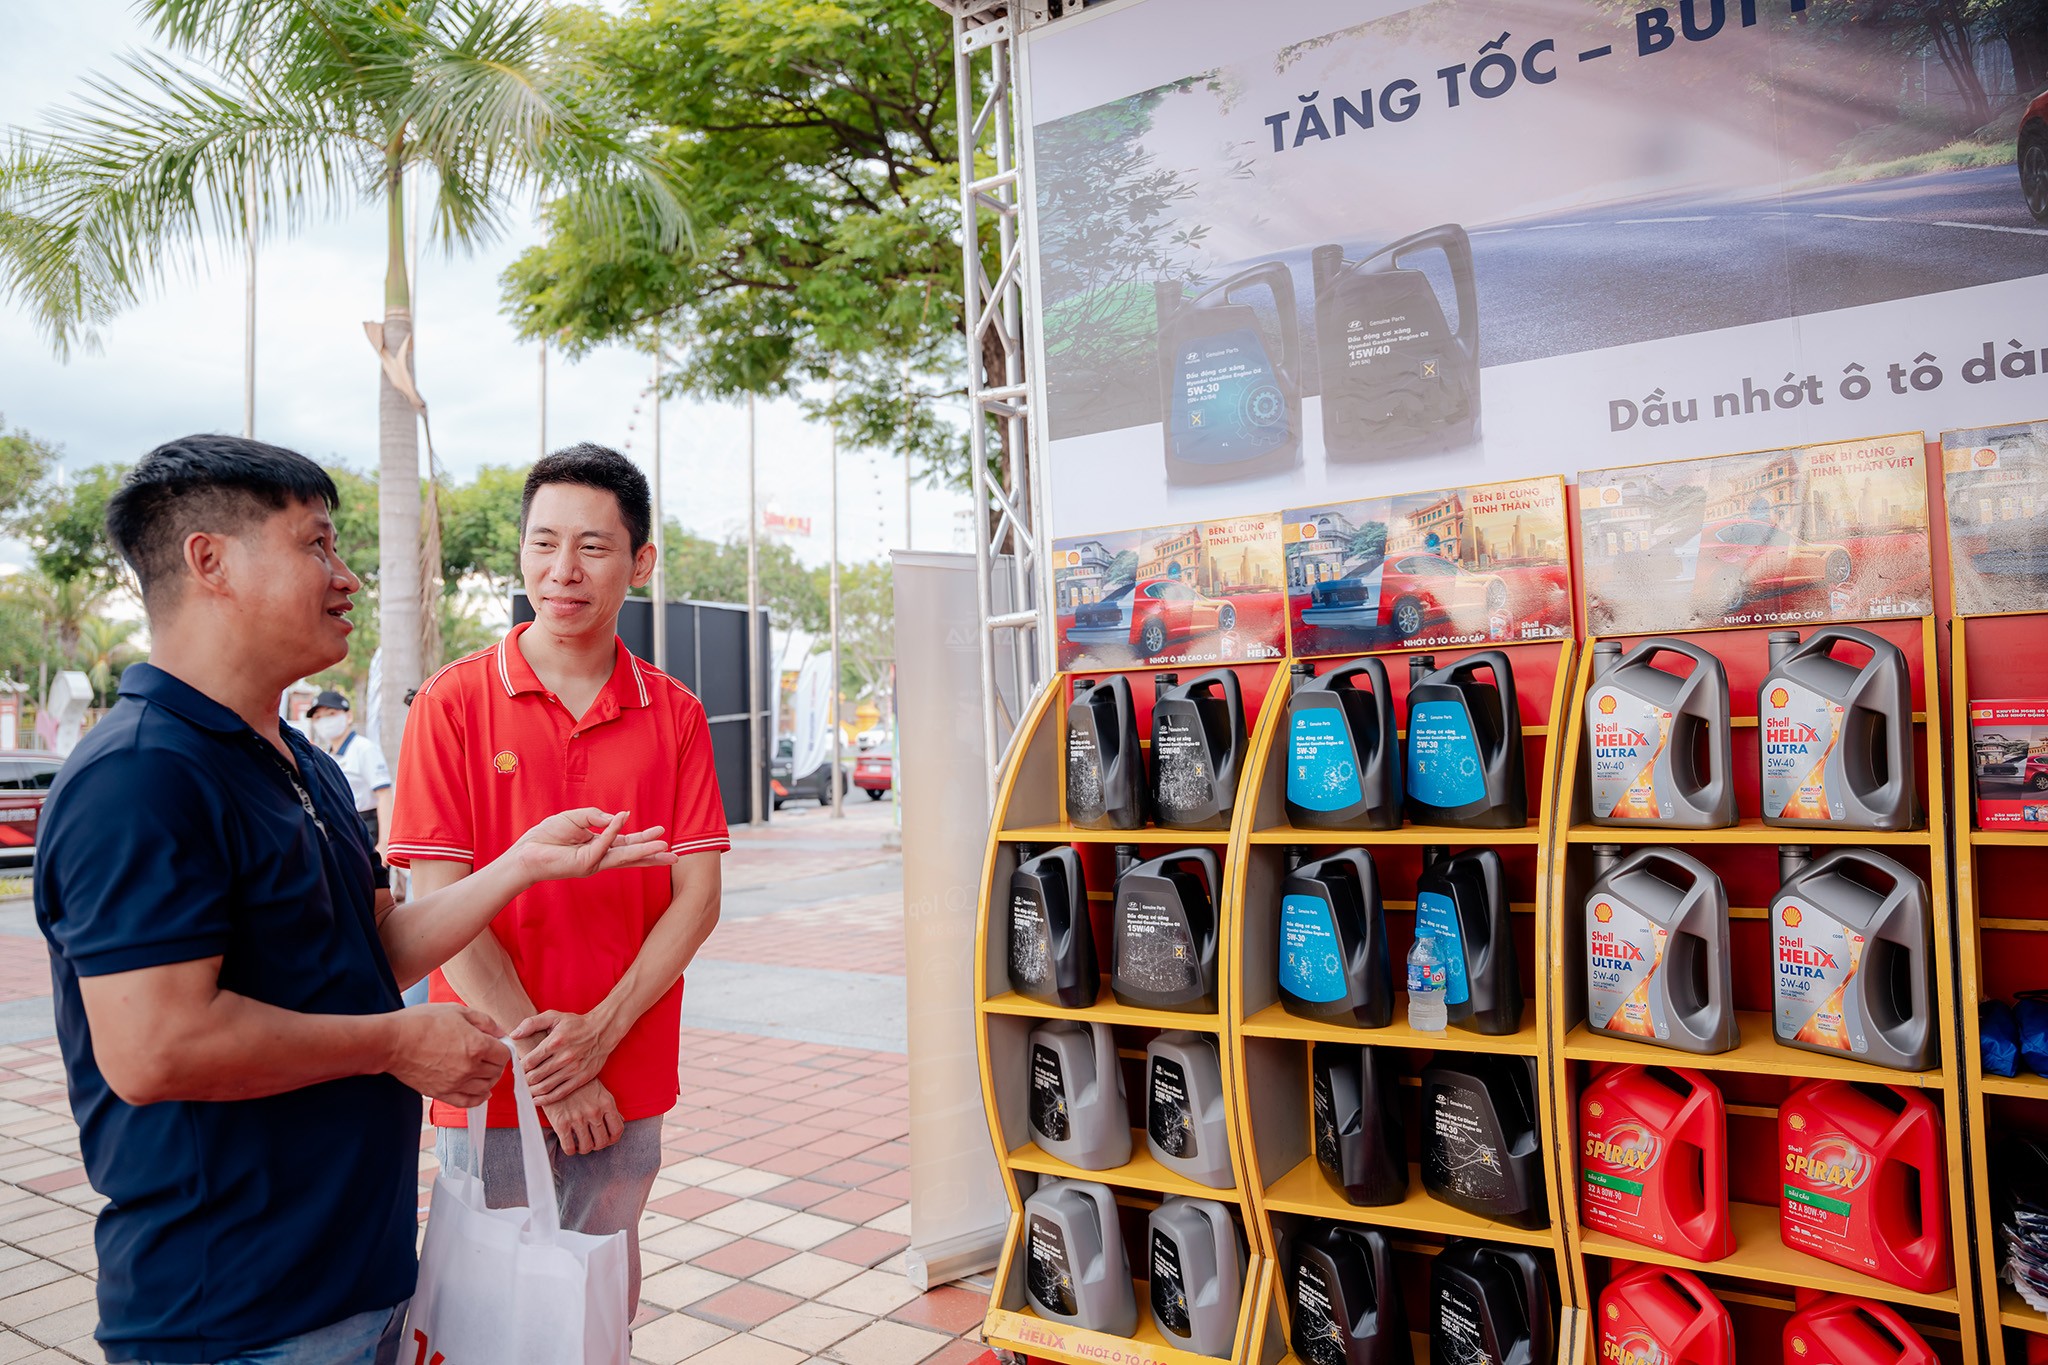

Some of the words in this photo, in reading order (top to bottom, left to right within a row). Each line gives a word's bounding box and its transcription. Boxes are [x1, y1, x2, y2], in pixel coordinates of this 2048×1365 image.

[1264, 78, 1422, 153] TĂNG
[1437, 31, 1557, 108] TỐC
[1369, 318, 1390, 327] Genuine
[1348, 341, 1371, 350] Hyundai
[1372, 337, 1398, 346] Gasoline
[1398, 333, 1419, 342] Engine
[1226, 347, 1239, 355] Parts
[1349, 345, 1390, 360] 15W/40
[1187, 383, 1219, 397] 5W-30
[1608, 386, 1698, 432] Dầu
[1713, 371, 1823, 418] nhớt
[1839, 361, 1871, 401] ô
[1887, 351, 1943, 394] tô
[1811, 466, 1842, 477] TINH
[1887, 456, 1914, 469] VIỆT
[1473, 505, 1498, 515] TINH
[1209, 536, 1230, 546] TINH
[1869, 596, 1891, 605] Shell
[1870, 600, 1922, 615] HELIX
[1724, 613, 1751, 624] NHỚT
[1753, 612, 1762, 622] Ô
[1765, 612, 1778, 622] TÔ
[1780, 611, 1801, 621] CAO
[1521, 621, 1539, 629] Shell
[1522, 624, 1563, 639] HELIX
[1247, 642, 1261, 650] Shell
[1403, 637, 1427, 647] NHỚT
[1428, 636, 1436, 645] Ô
[1437, 635, 1449, 645] TÔ
[1450, 634, 1467, 644] CAO
[1469, 632, 1485, 642] CẤP
[1149, 655, 1168, 664] NHỚT
[1177, 654, 1186, 663] TÔ
[1187, 653, 1202, 662] CAO
[1247, 645, 1281, 658] HELIX
[1595, 722, 1618, 733] Shell
[1767, 717, 1790, 727] Shell
[1596, 728, 1649, 747] HELIX
[1767, 723, 1821, 742] HELIX
[1296, 747, 1318, 755] 5W-30
[1416, 741, 1439, 749] 5W-30
[1767, 744, 1809, 755] ULTRA
[1596, 748, 1637, 758] ULTRA
[1597, 761, 1625, 771] 5W-40
[1767, 758, 1795, 768] 5W-40
[1127, 924, 1155, 934] 15W/40
[1592, 930, 1614, 942] Shell
[1287, 932, 1306, 942] 5W-30
[1779, 935, 1803, 949] Shell
[1592, 939, 1643, 961] HELIX
[1779, 945, 1838, 969] HELIX
[1592, 957, 1633, 972] ULTRA
[1780, 963, 1825, 980] ULTRA
[1593, 970, 1620, 983] 5W-40
[1780, 977, 1811, 992] 5W-40
[1436, 1121, 1458, 1135] 5W-30
[1587, 1130, 1602, 1139] Shell
[1585, 1139, 1649, 1171] SPIRAX
[1787, 1144, 1803, 1154] Shell
[1785, 1153, 1857, 1189] SPIRAX
[1588, 1184, 1596, 1193] S2
[1596, 1187, 1601, 1195] A
[1601, 1188, 1622, 1201] 80W-90
[1788, 1200, 1797, 1211] S2
[1798, 1204, 1803, 1213] A
[1803, 1205, 1827, 1220] 80W-90
[1441, 1316, 1460, 1334] 5W-30
[1018, 1327, 1067, 1351] HELIX
[1076, 1343, 1110, 1358] NHỚT
[1603, 1340, 1652, 1365] SPIR
